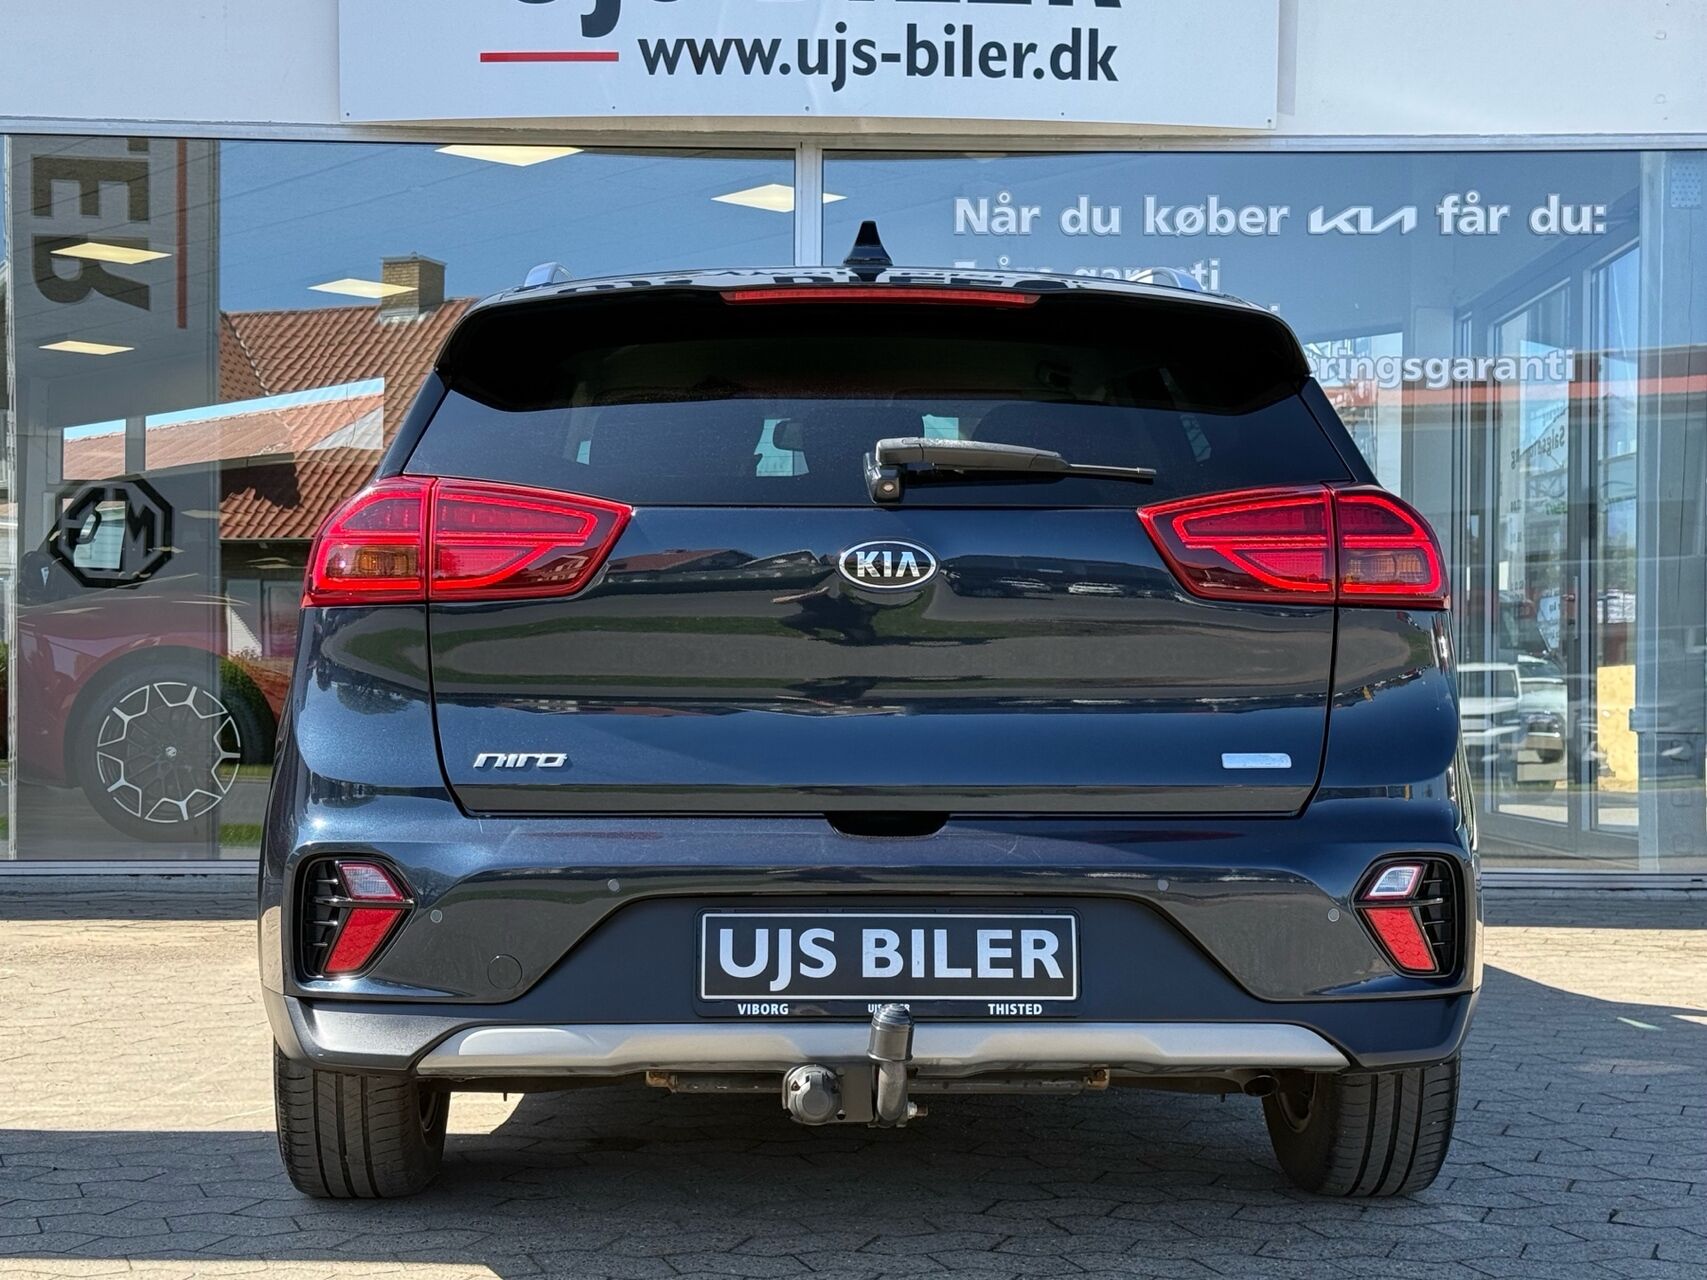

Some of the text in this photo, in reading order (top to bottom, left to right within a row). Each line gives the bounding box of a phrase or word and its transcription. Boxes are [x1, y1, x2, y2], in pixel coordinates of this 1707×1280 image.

[638, 22, 1119, 92] www.ujs-biler.dk
[954, 191, 1040, 235] Når
[1060, 194, 1121, 235] du
[1144, 194, 1290, 236] køber
[1436, 190, 1510, 234] får
[1528, 193, 1607, 234] du:
[856, 551, 921, 578] KIA
[719, 928, 1064, 991] UJS BILER
[737, 1003, 789, 1015] VIBORG
[987, 1003, 1043, 1015] THISTED
